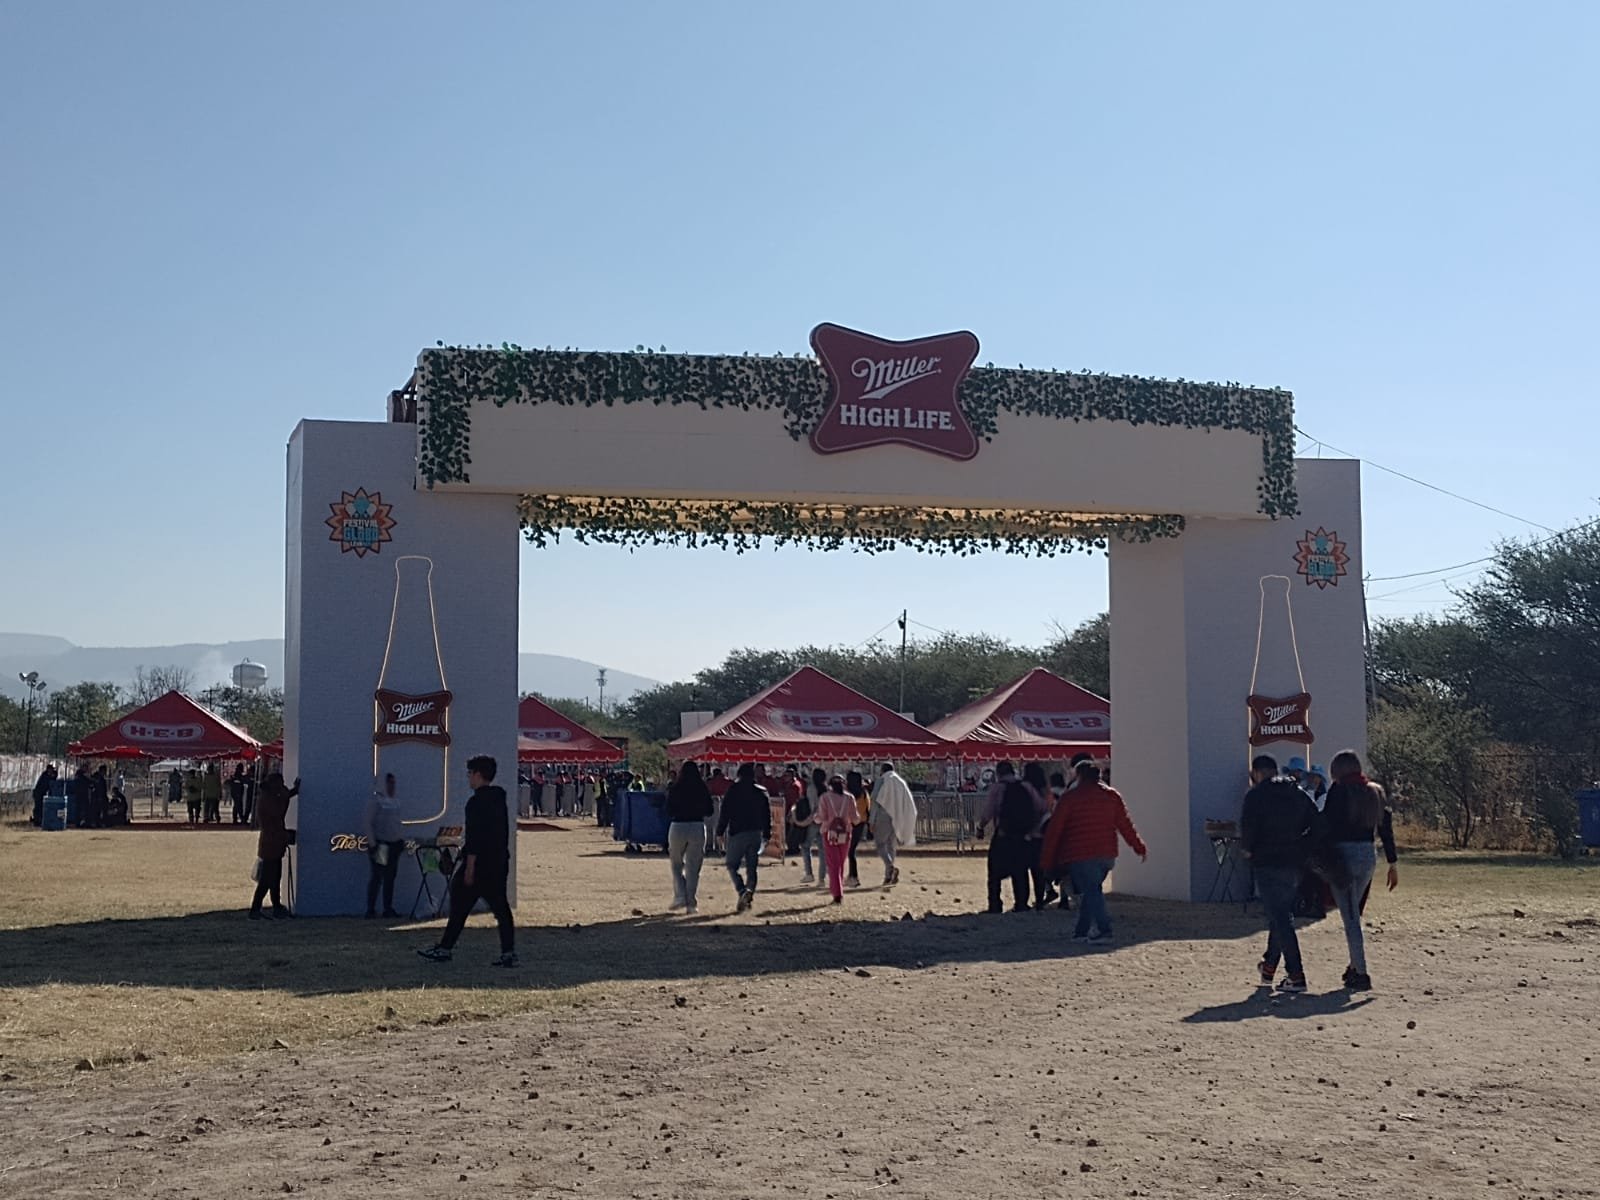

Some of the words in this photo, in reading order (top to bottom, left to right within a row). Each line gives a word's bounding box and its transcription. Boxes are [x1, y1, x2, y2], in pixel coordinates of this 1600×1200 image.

[851, 356, 942, 399] Miller
[840, 404, 899, 428] HIGH
[392, 702, 436, 721] Miller
[1264, 704, 1299, 724] Miller
[386, 723, 414, 734] HIGH
[1261, 725, 1284, 735] HIGH
